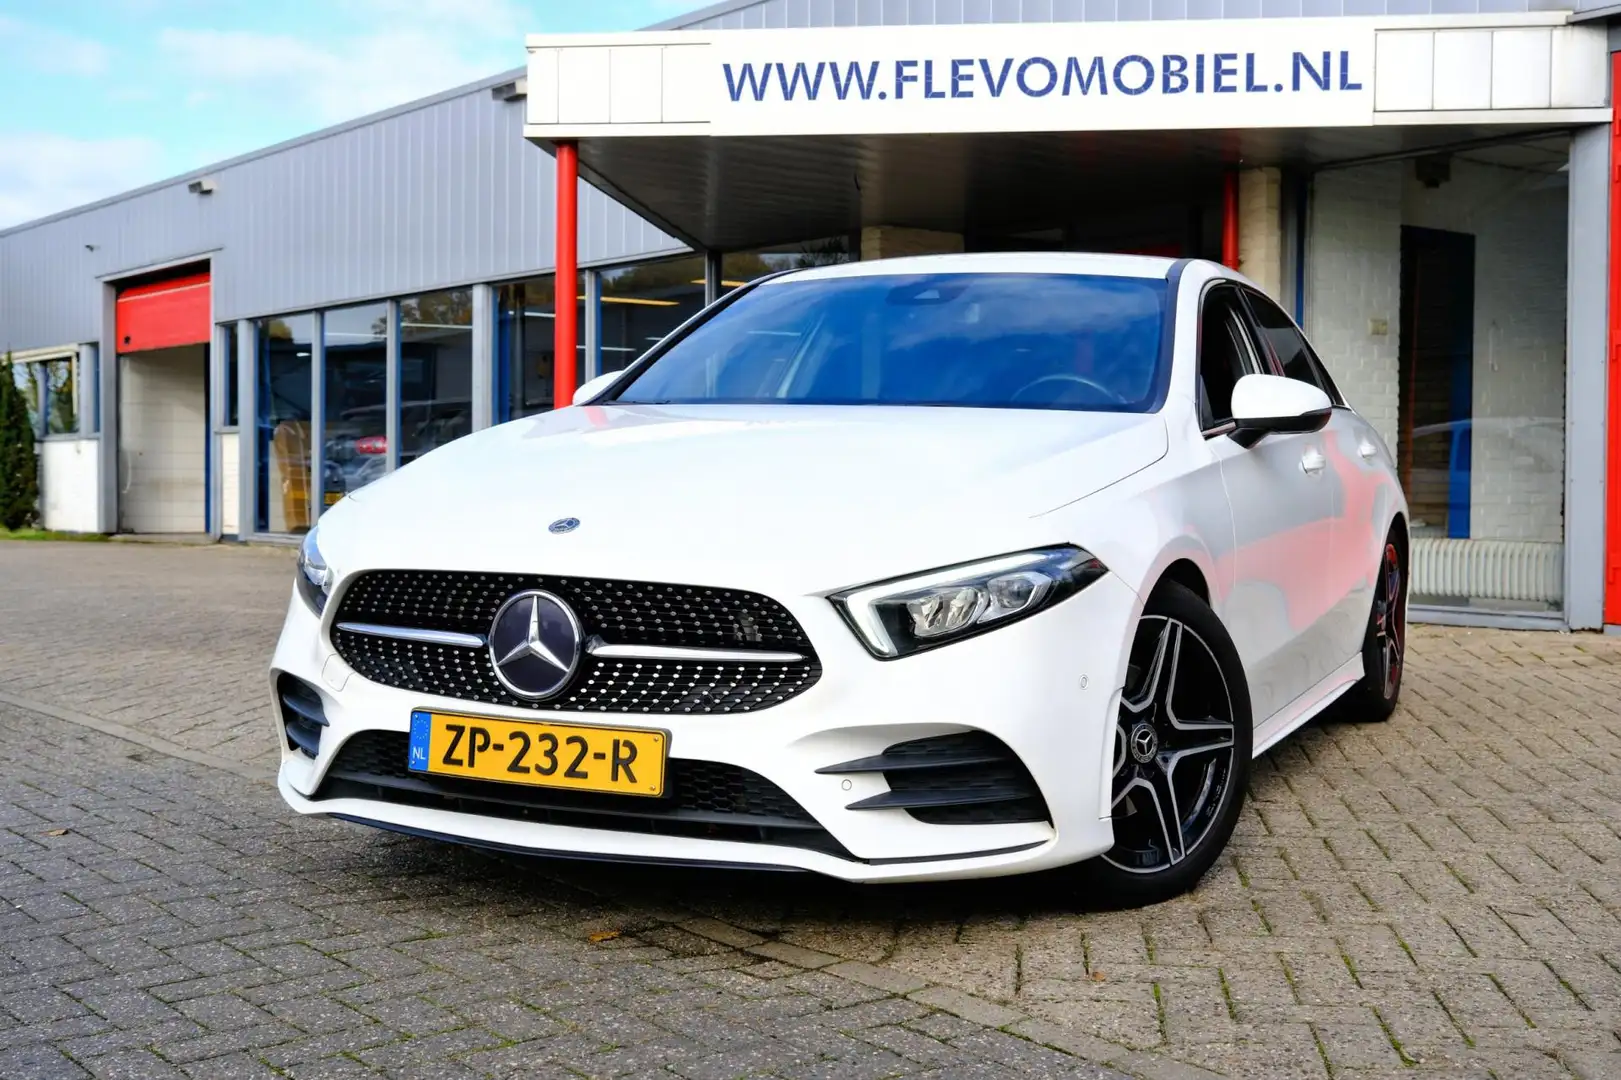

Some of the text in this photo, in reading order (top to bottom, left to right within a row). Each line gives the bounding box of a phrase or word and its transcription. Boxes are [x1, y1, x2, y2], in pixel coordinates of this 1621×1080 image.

[723, 50, 1363, 102] WWW.FLEVOMOBIEL.NL
[412, 746, 427, 761] NL
[442, 723, 638, 784] ZP-232-R
